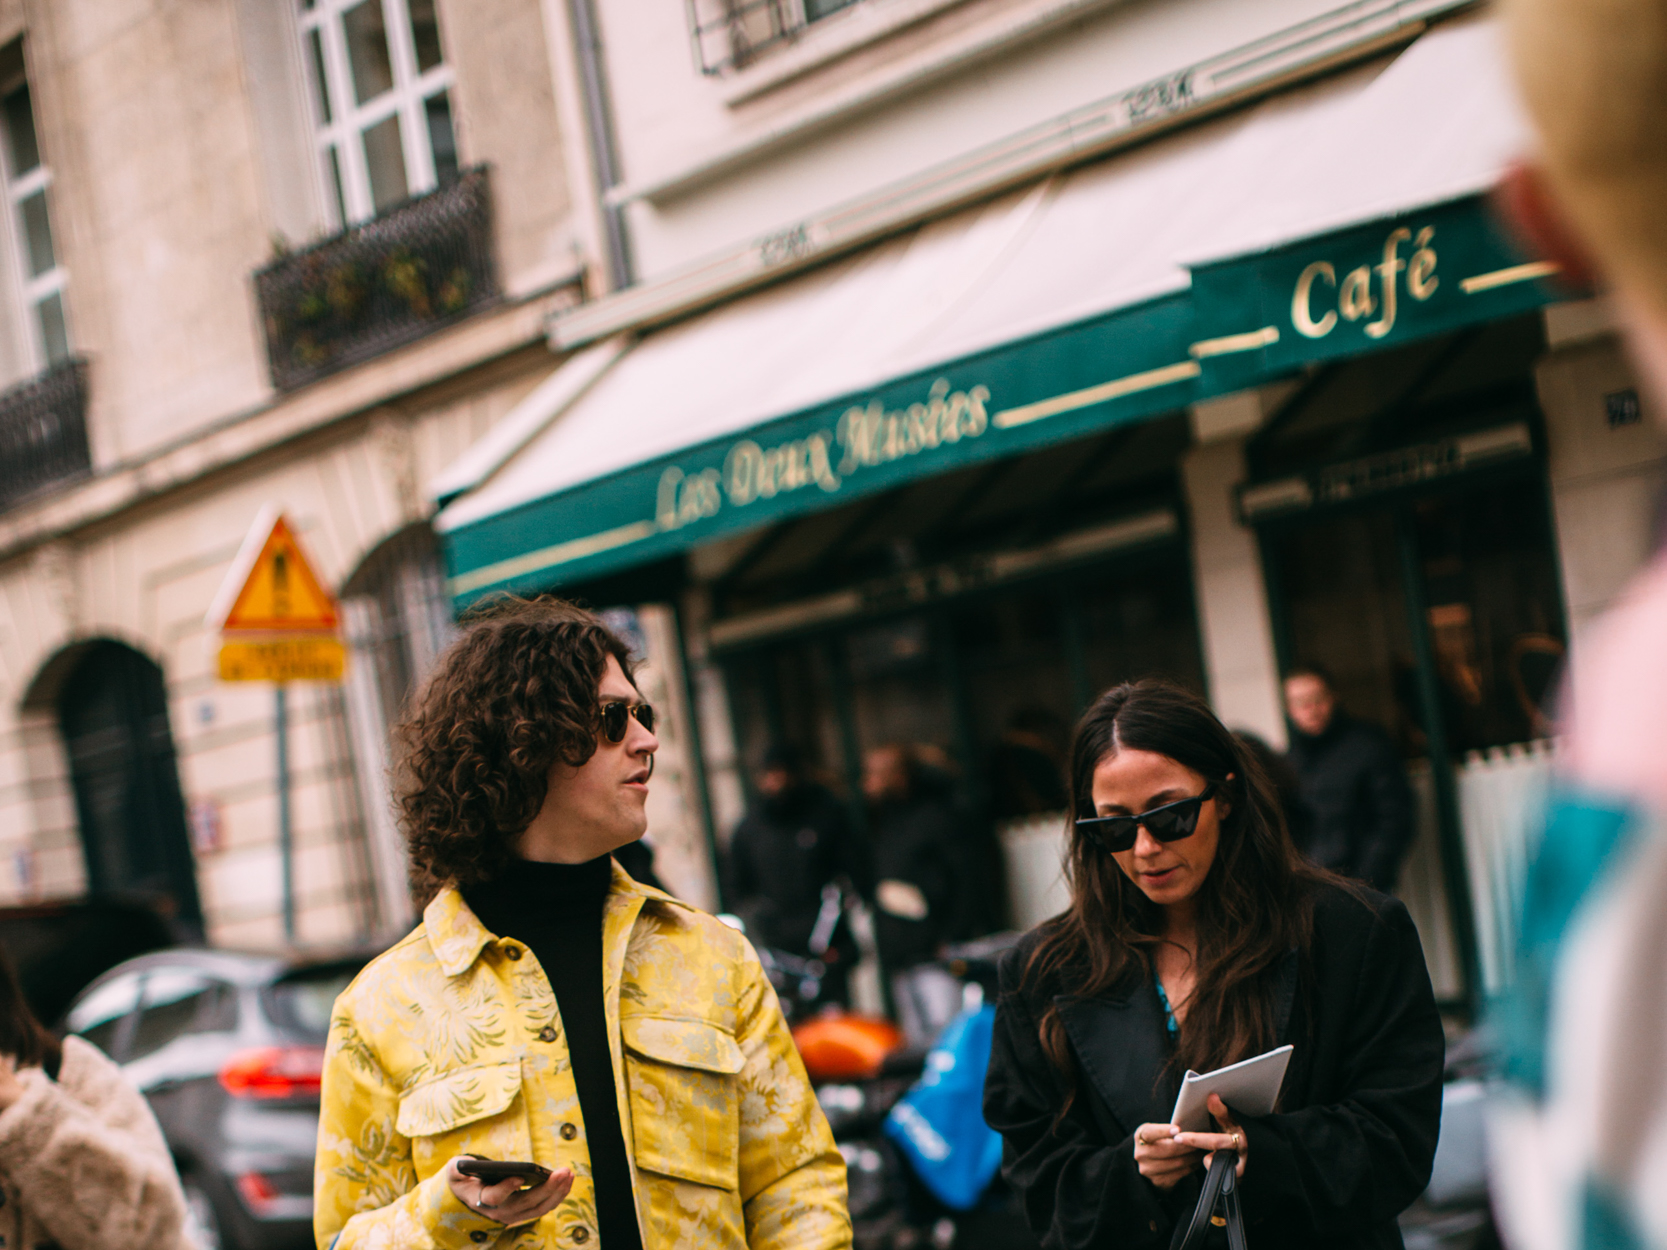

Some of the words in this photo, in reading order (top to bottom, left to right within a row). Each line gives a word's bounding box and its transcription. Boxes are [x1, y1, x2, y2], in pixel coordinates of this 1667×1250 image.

[1291, 225, 1440, 339] Café
[655, 465, 722, 532] Les
[723, 429, 842, 507] Deux
[836, 377, 991, 476] Musées
